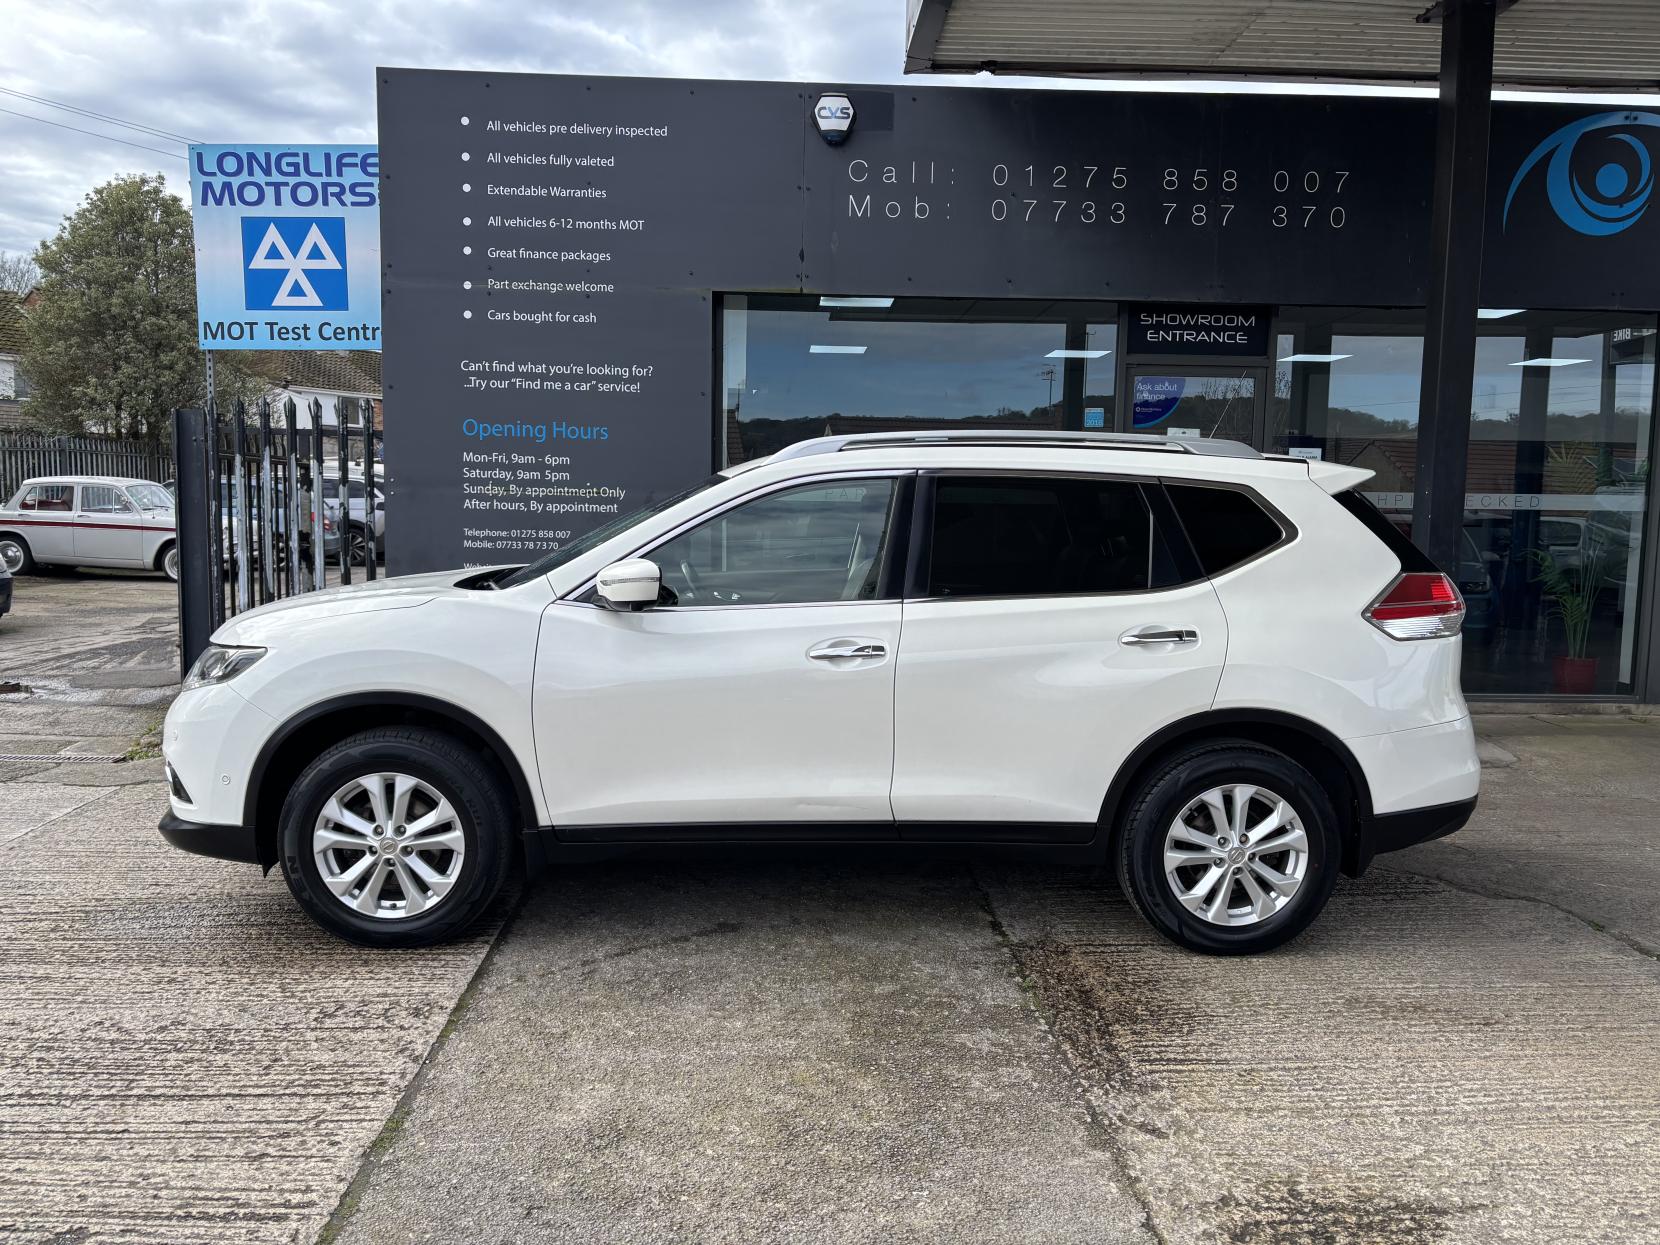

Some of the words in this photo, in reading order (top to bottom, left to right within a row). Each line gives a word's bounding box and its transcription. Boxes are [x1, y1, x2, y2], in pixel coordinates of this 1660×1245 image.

[487, 120, 500, 131] All
[503, 121, 546, 132] vehicles
[550, 125, 567, 135] pre
[570, 123, 612, 137] delivery
[616, 125, 667, 138] inspected
[196, 151, 379, 178] LONGLIFE
[487, 153, 500, 163] All
[504, 153, 546, 164] vehicles
[550, 154, 572, 167] fully
[575, 155, 614, 166] valeted
[848, 159, 955, 185] Call:
[992, 164, 1128, 190] 01275
[1163, 167, 1238, 192] 858
[1272, 170, 1350, 195] 007
[200, 181, 376, 207] MOTORS
[488, 185, 547, 196] Extendable
[550, 186, 606, 198] Warranties
[848, 195, 952, 220] Mob:
[991, 199, 1127, 223] 07733
[1162, 203, 1235, 226] 787
[1272, 205, 1346, 229] 370
[488, 216, 501, 226] All
[504, 217, 546, 227] vehicles
[549, 218, 573, 228] 6-12
[576, 219, 616, 229] months
[620, 220, 644, 230] MOT
[488, 248, 516, 258] Great
[519, 248, 558, 259] finance
[561, 250, 610, 263] packages
[488, 279, 509, 289] Part
[512, 280, 563, 293] exchange
[565, 281, 614, 292] welcome
[488, 310, 510, 320] Cars
[514, 310, 552, 323] bought
[555, 312, 570, 322] for
[573, 312, 596, 323] cash
[1140, 313, 1255, 327] SHOWROOM
[202, 321, 258, 341] MOT
[265, 321, 311, 341] Test
[318, 321, 381, 341] Centr
[1146, 330, 1248, 344] ENTRANCE
[461, 360, 490, 371] Can't
[492, 361, 514, 372] find
[518, 362, 546, 373] what
[549, 363, 583, 376] you're
[587, 364, 629, 378] looking
[632, 365, 653, 376] for?
[544, 382, 561, 390] me
[565, 382, 570, 390] a
[598, 382, 640, 392] service!
[1136, 382, 1153, 391] Ask
[1154, 381, 1178, 391] about
[463, 419, 546, 442] Opening
[553, 422, 608, 439] Hours
[463, 452, 508, 464] Mon-Fri,
[511, 453, 535, 463] 9am
[545, 455, 569, 467] 6pm
[464, 468, 514, 482] Saturday,
[517, 470, 540, 479] 9am
[545, 470, 569, 482] 5pm
[464, 481, 506, 496] Sunday,
[510, 484, 523, 497] By
[525, 485, 597, 498] appointment
[600, 487, 625, 500] Only
[464, 499, 491, 509] After
[494, 499, 527, 511] hours,
[531, 501, 543, 513] By
[546, 502, 618, 514] appointment
[464, 528, 509, 538] Telephone:
[539, 530, 553, 538] 858
[464, 540, 494, 548] Mobile:
[496, 541, 521, 549] 07733
